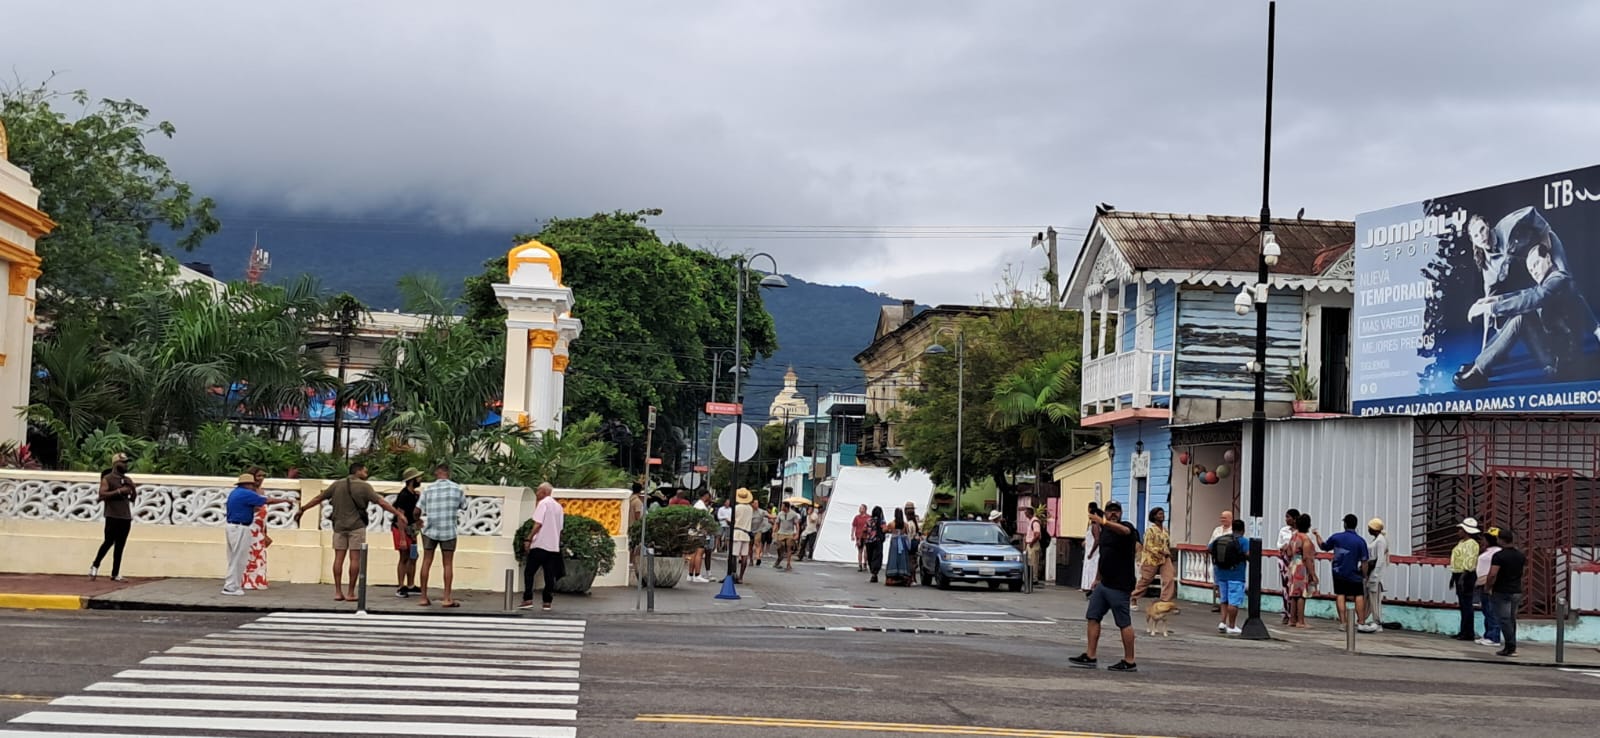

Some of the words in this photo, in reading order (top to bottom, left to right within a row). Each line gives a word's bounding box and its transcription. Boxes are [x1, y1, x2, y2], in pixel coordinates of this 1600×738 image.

[1544, 179, 1574, 210] LTB
[1360, 269, 1390, 286] NUEVA
[1360, 280, 1434, 307] TEMPORADA
[1362, 319, 1379, 333] MAS
[1380, 314, 1420, 330] VARIEDAD
[1362, 339, 1398, 354] MEJORES
[1445, 400, 1472, 413] PARA
[1475, 396, 1515, 412] DAMAS
[1518, 395, 1526, 408] Y
